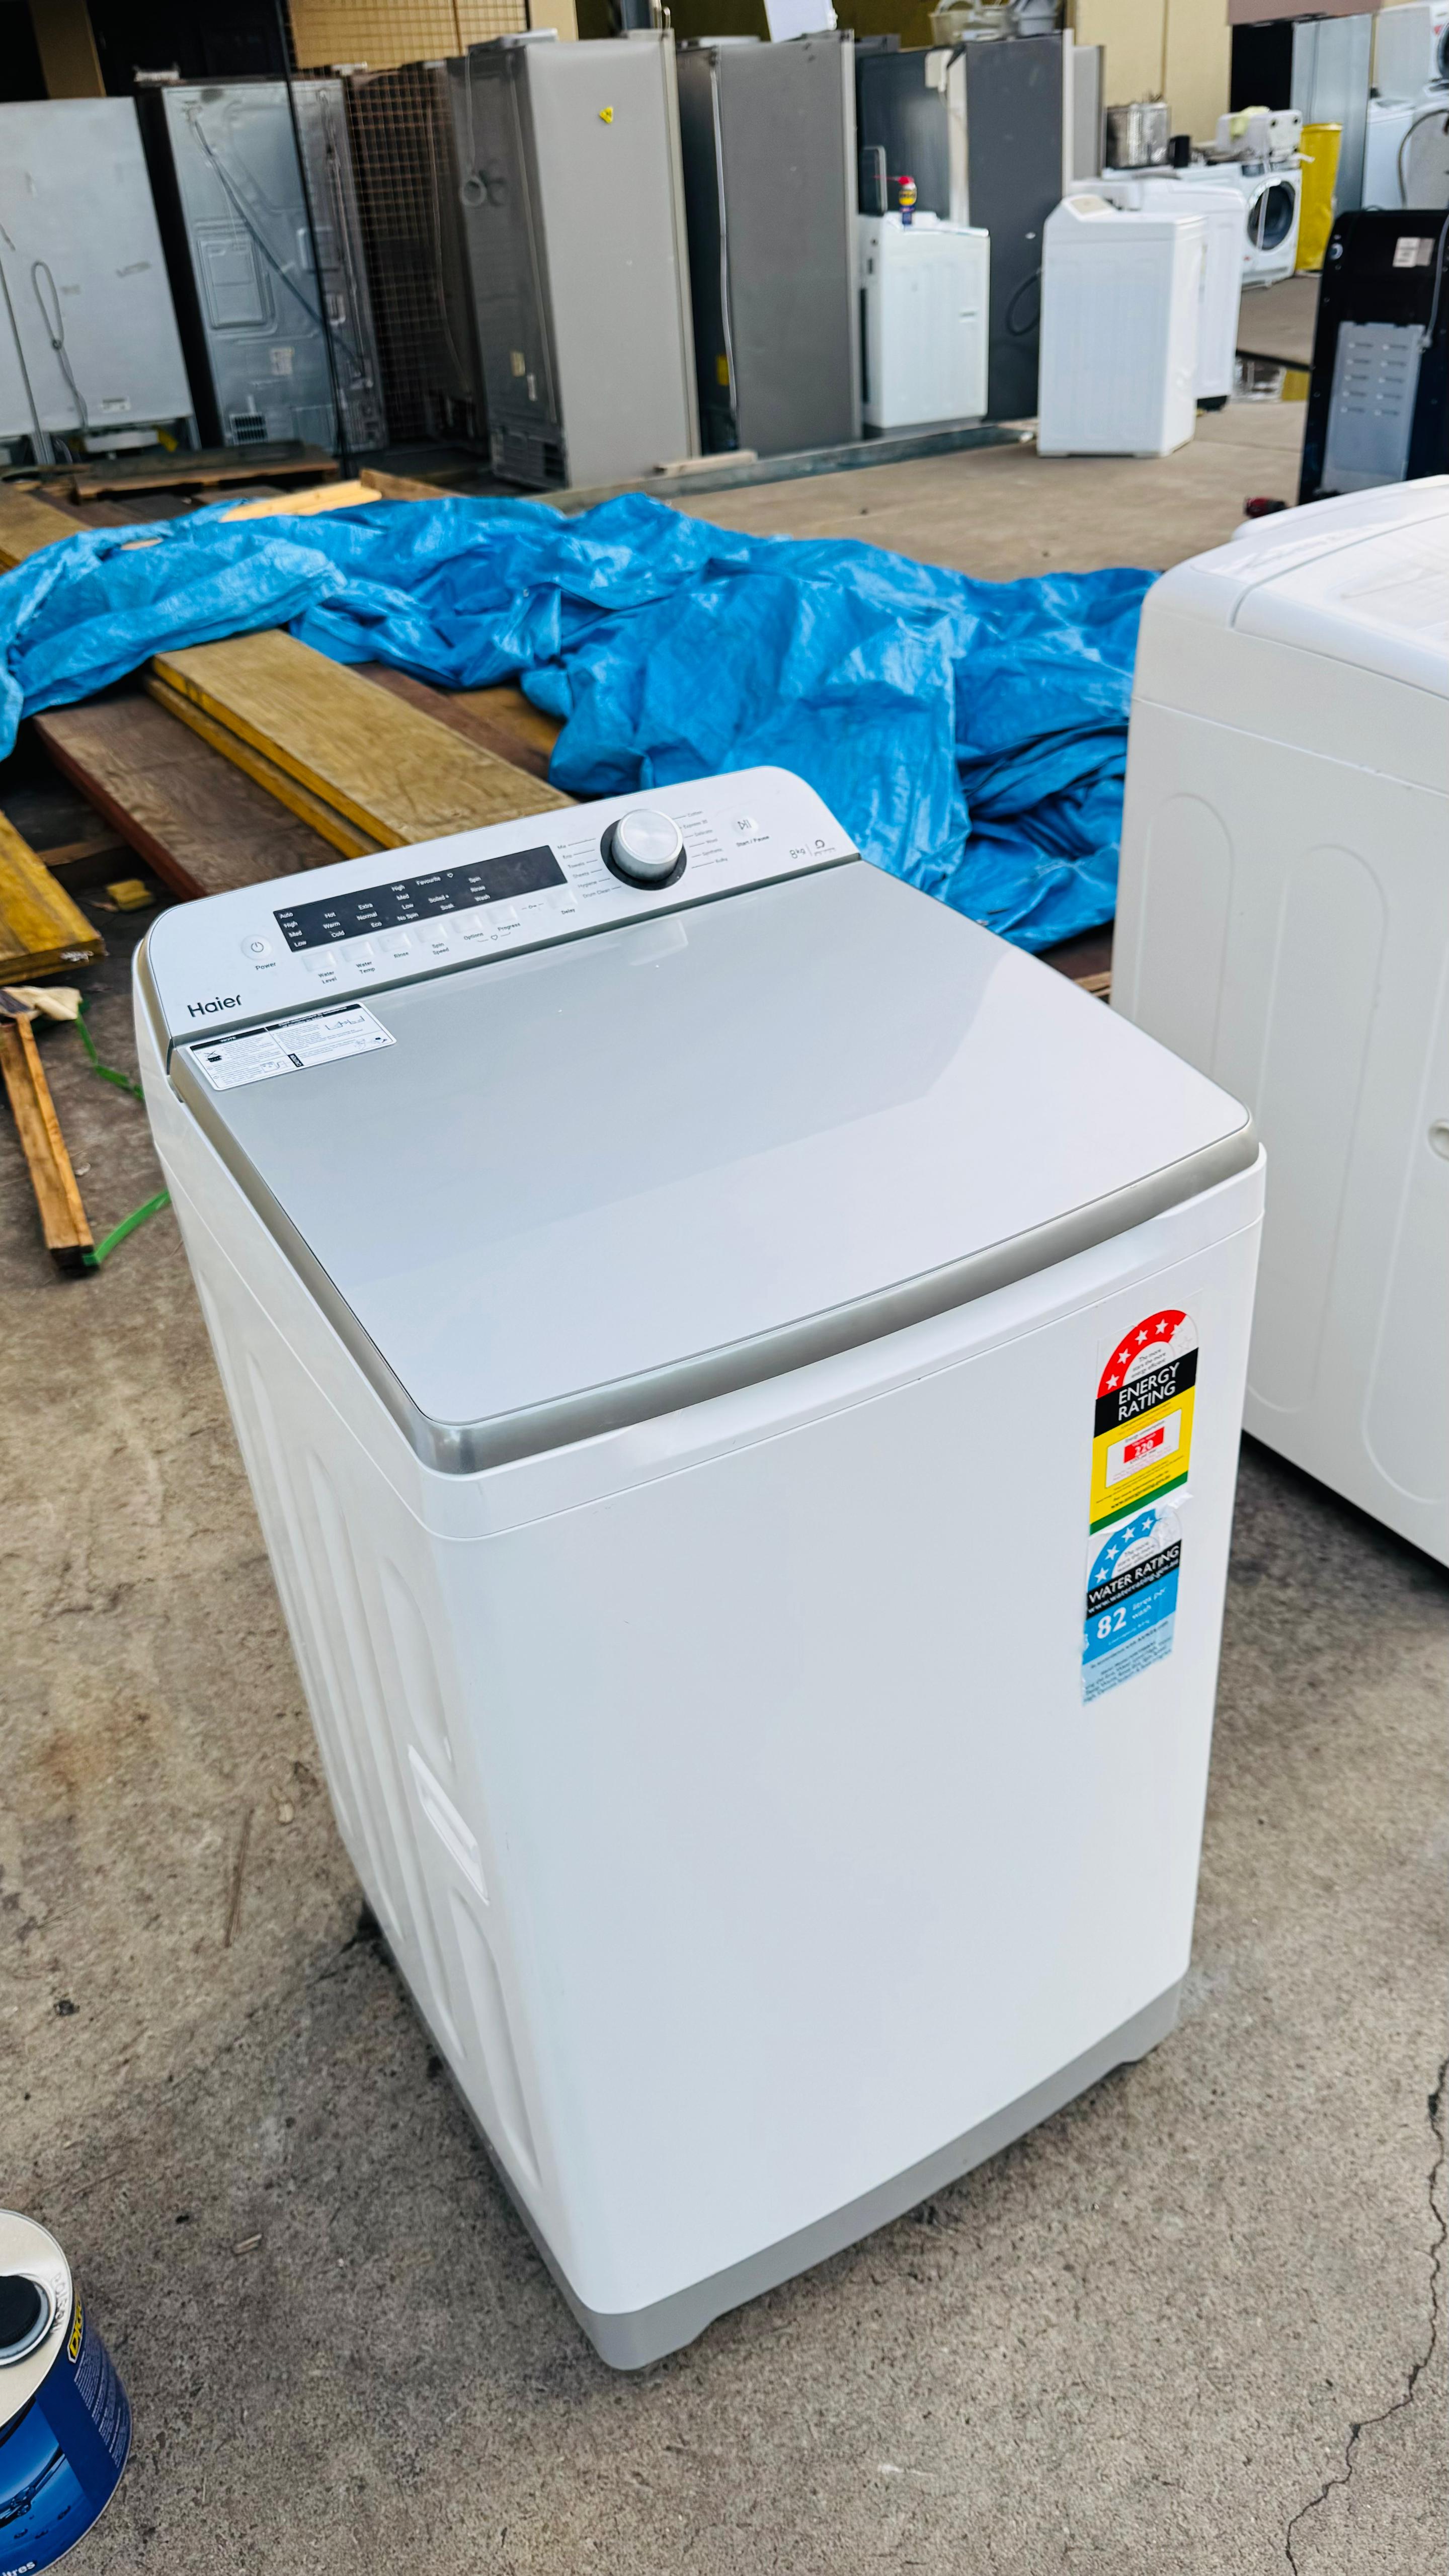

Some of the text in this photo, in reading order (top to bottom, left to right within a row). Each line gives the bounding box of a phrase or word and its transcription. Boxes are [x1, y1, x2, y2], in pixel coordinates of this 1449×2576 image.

[416, 876, 441, 886] Favourite
[578, 880, 597, 889] Hygiene
[356, 912, 378, 921] Normal
[323, 921, 341, 929] Warm
[498, 923, 521, 932] Progress
[464, 932, 484, 941] Options
[433, 947, 450, 955] Speed
[255, 962, 276, 971] Power
[187, 994, 242, 1017] Haier
[1118, 1361, 1180, 1405] ENERGY
[1118, 1380, 1176, 1421] RATING
[1089, 1545, 1180, 1603] WATER RATING
[1088, 1558, 1179, 1614] www.waterrating.gov.au
[1133, 1586, 1167, 1610] litres per
[1132, 1604, 1152, 1619] wash
[1097, 1606, 1127, 1640] 82
